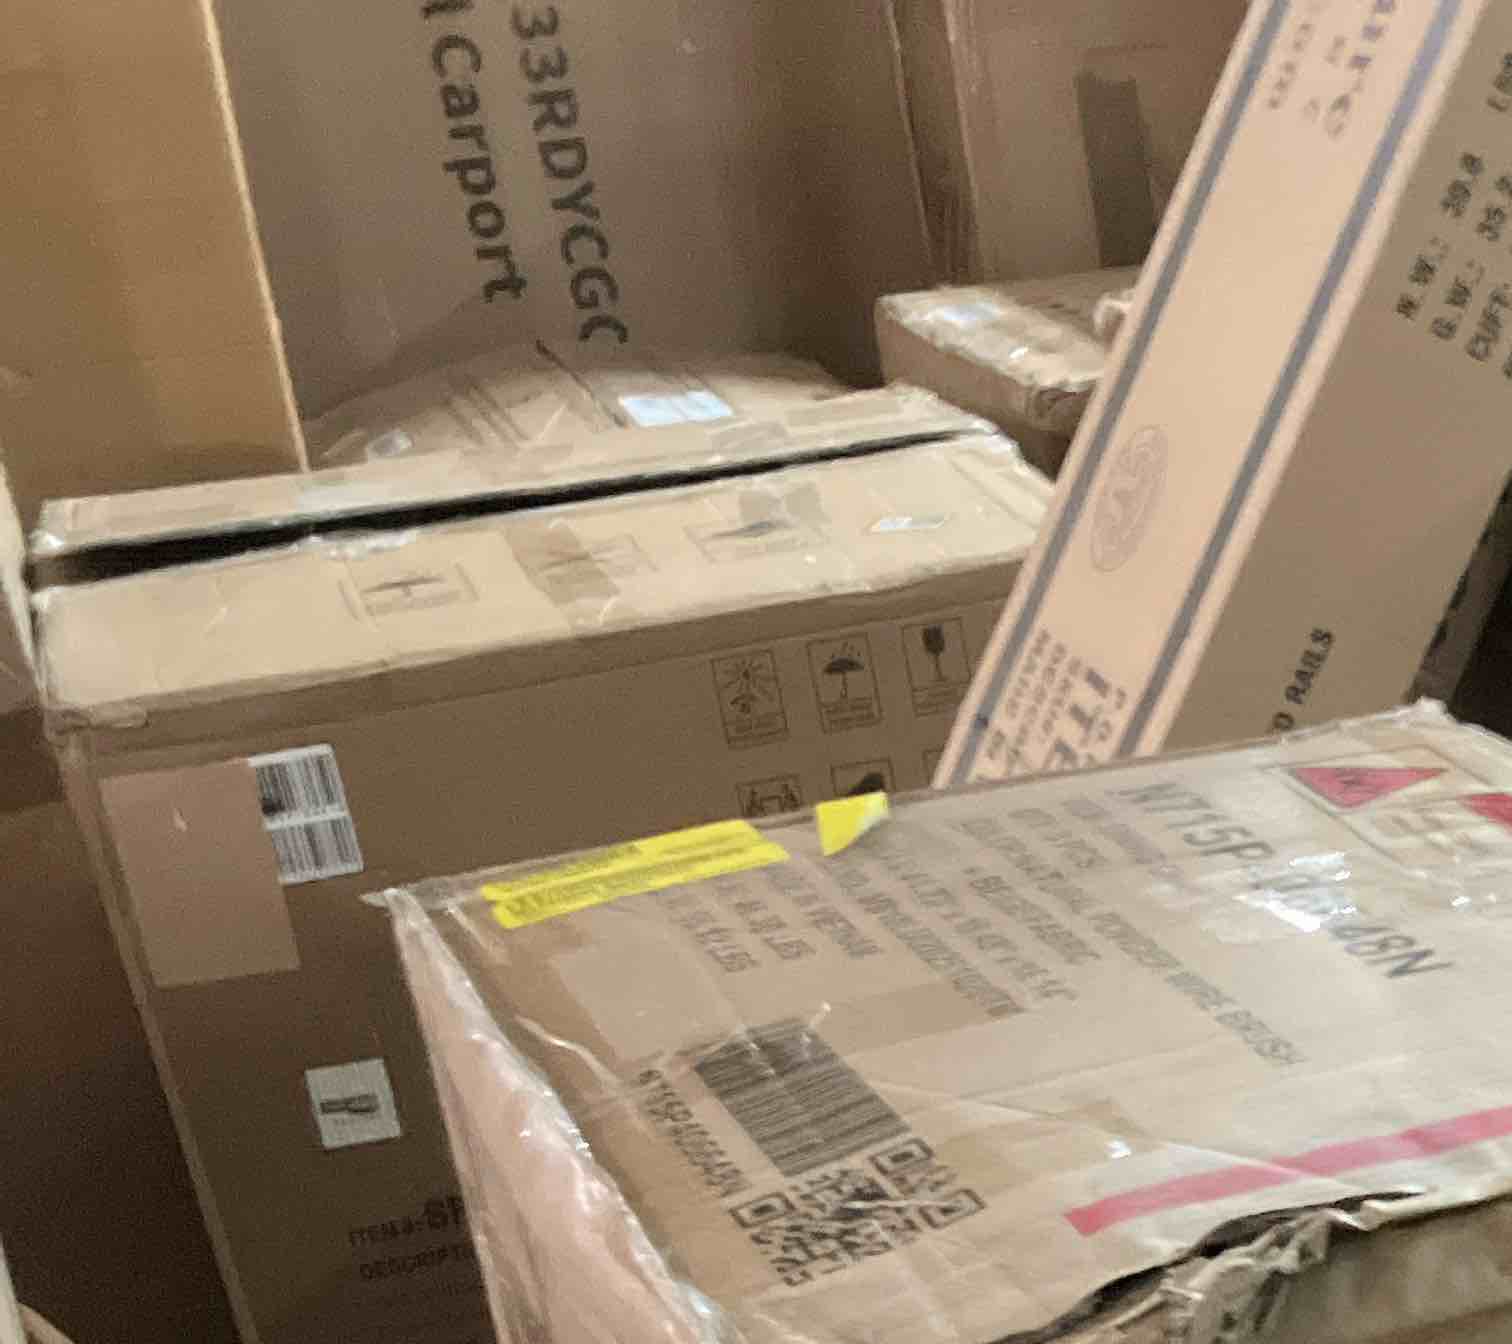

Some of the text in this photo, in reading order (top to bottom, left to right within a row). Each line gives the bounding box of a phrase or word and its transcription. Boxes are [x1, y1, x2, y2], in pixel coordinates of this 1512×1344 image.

[432, 34, 528, 302] Carport
[1285, 628, 1335, 705] RAILS
[1158, 970, 1239, 1014] WIRE
[1209, 1009, 1308, 1067] BRUSH
